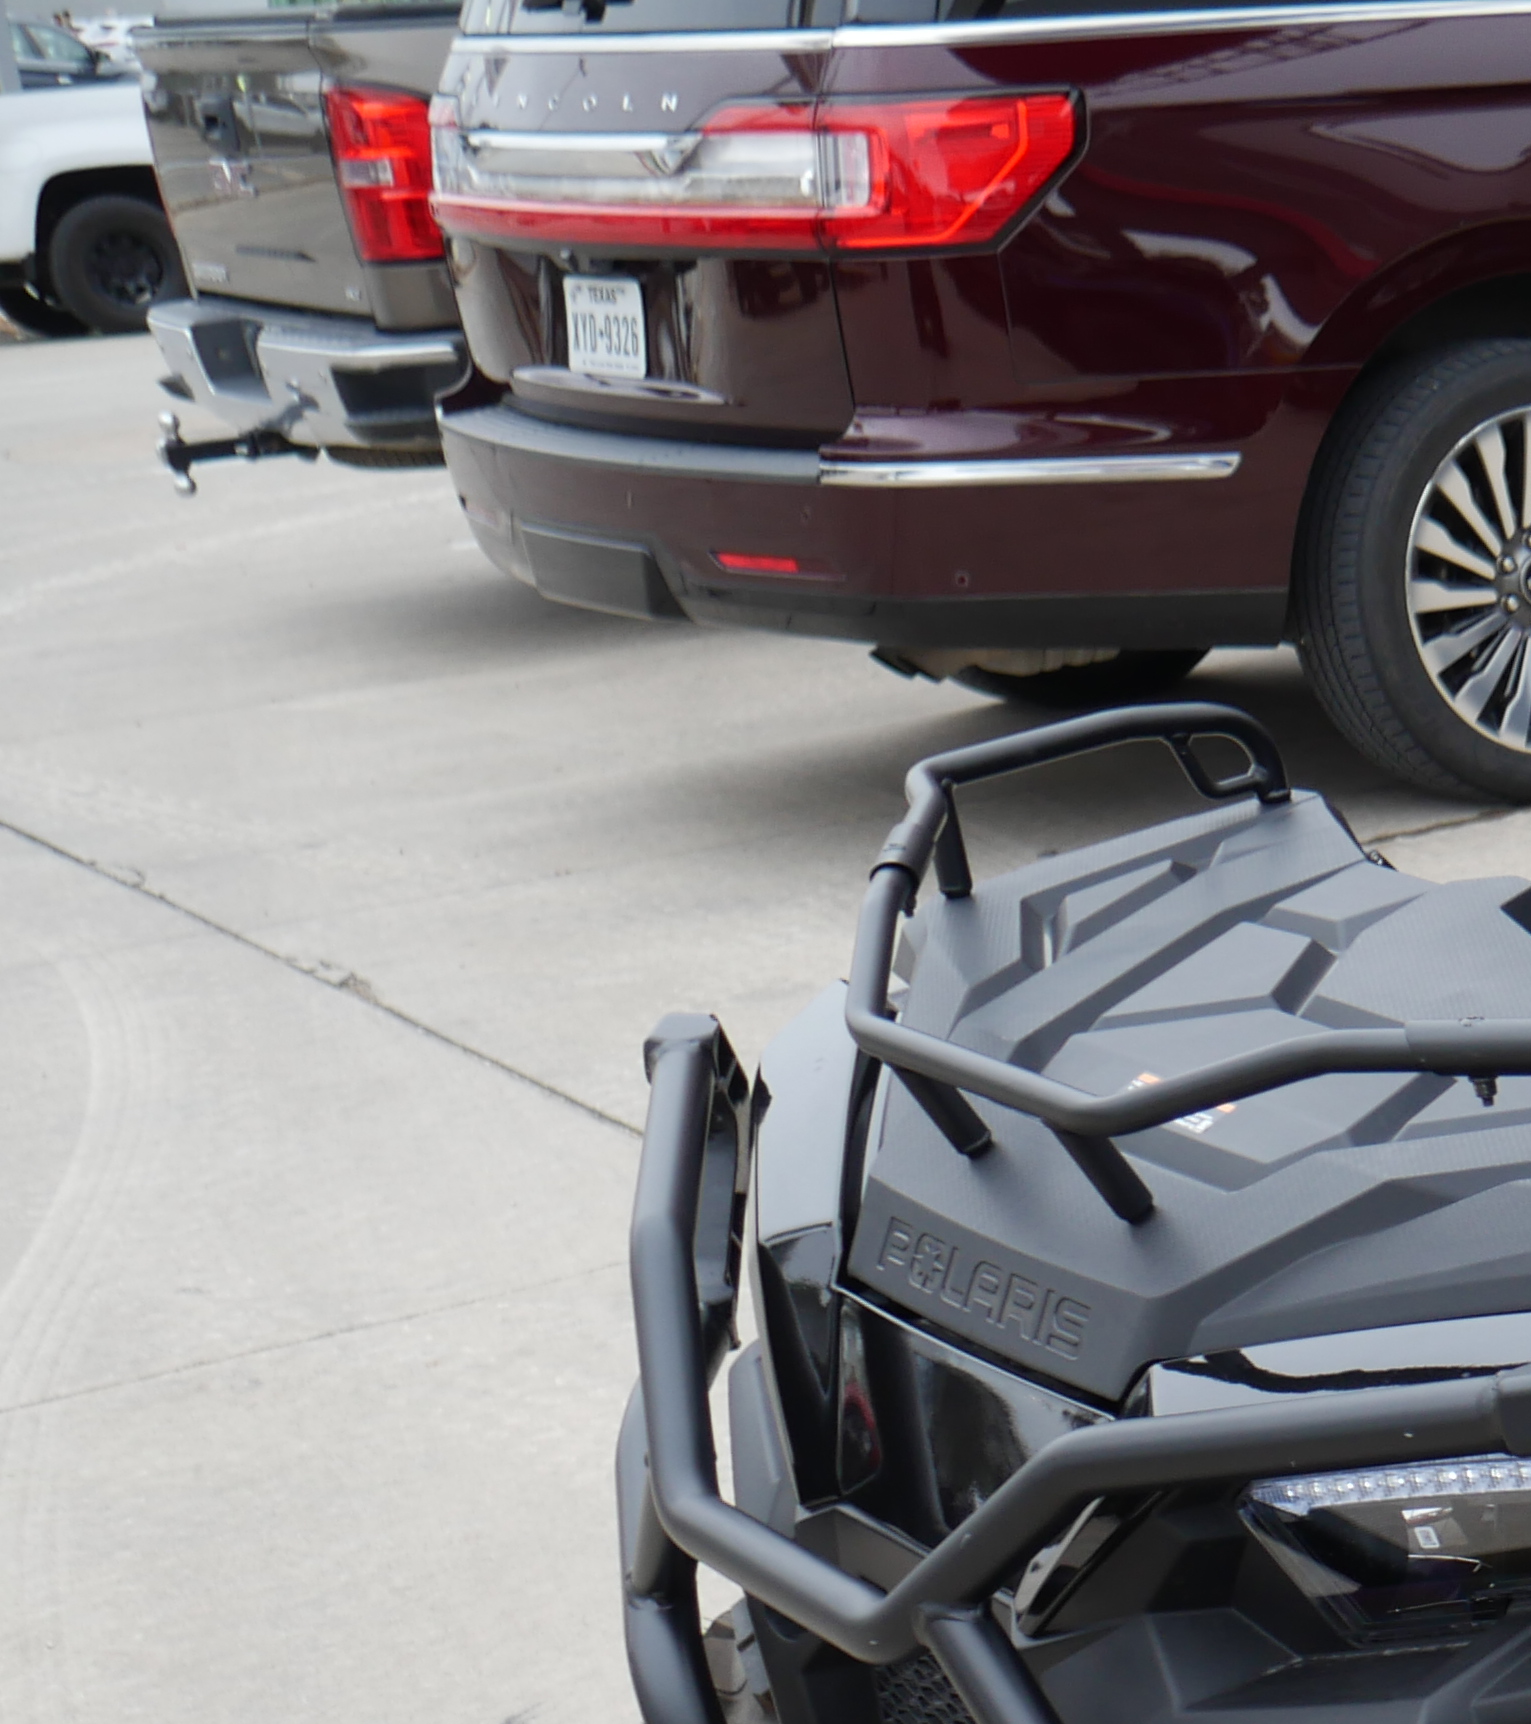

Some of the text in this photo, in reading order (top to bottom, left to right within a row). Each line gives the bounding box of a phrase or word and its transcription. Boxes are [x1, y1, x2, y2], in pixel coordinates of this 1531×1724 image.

[472, 92, 681, 113] INCOLN
[587, 286, 618, 304] TEXAS
[875, 1215, 1092, 1362] POLARIS
